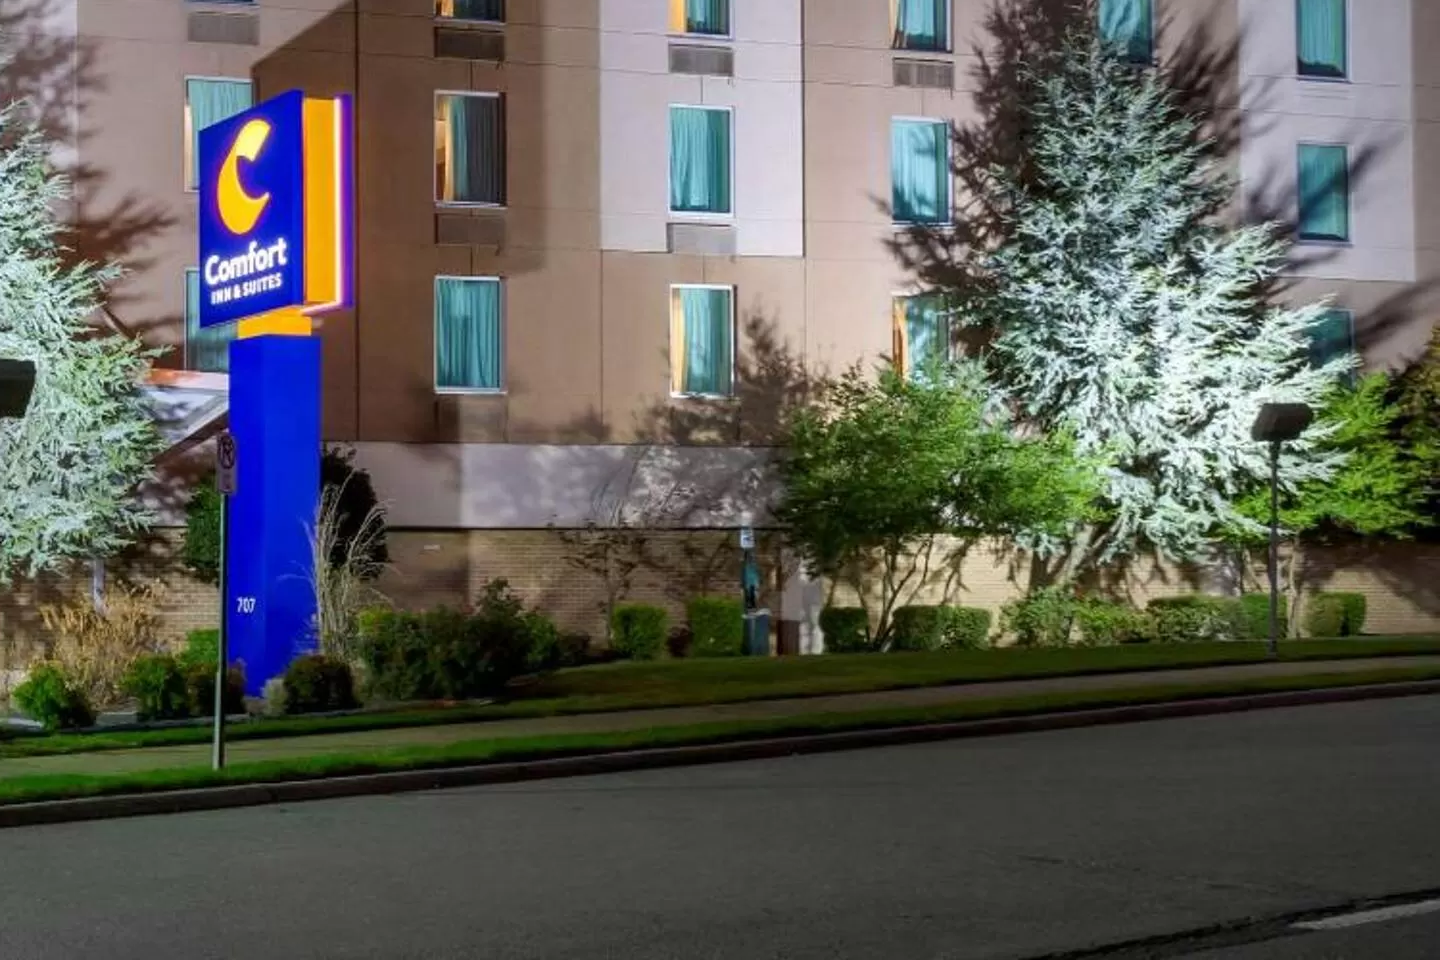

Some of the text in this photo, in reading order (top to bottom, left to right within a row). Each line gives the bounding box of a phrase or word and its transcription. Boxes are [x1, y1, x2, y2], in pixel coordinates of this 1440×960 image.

[205, 237, 287, 285] Comfort
[210, 287, 232, 305] INN
[242, 272, 282, 297] SUITES
[236, 596, 256, 614] 707
